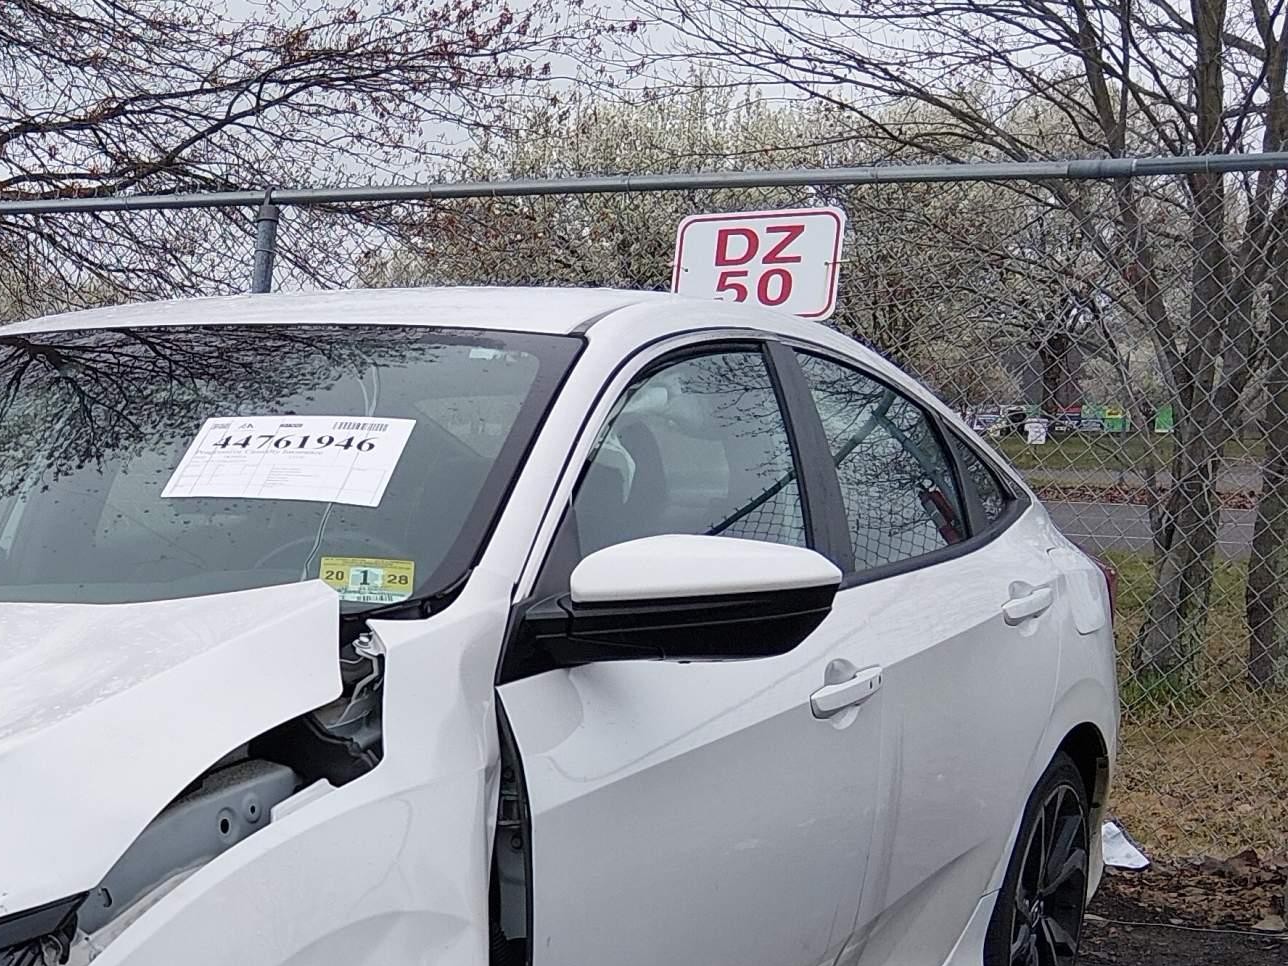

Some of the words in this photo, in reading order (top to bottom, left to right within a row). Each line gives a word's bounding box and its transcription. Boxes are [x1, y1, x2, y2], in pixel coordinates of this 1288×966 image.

[714, 224, 805, 267] DZ
[714, 268, 793, 306] 50
[213, 434, 380, 452] 44761946
[325, 570, 345, 581] 20
[359, 569, 370, 586] 1
[387, 574, 409, 585] 28
